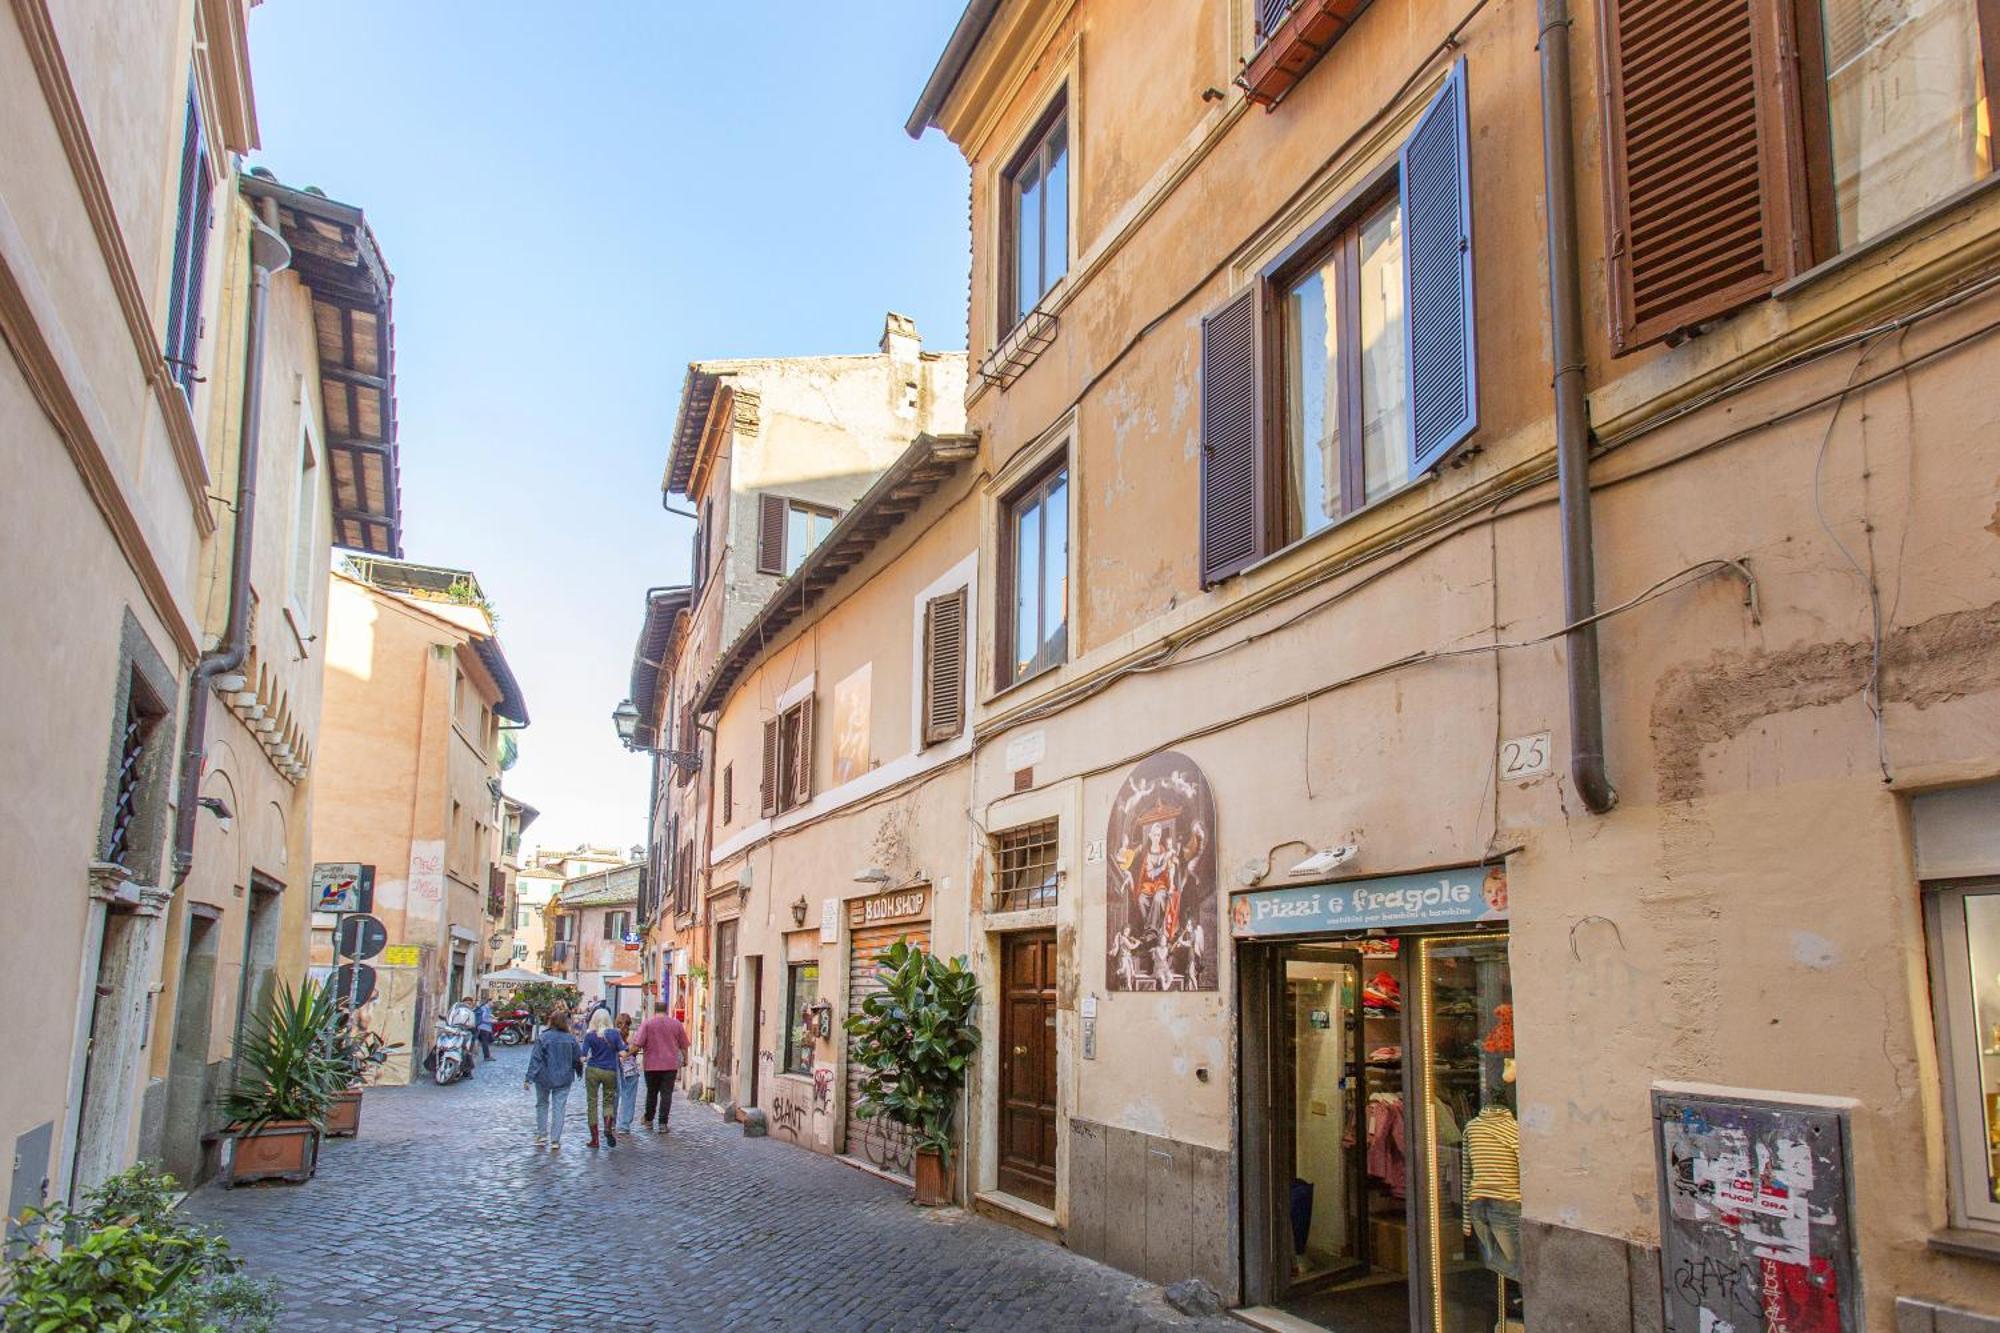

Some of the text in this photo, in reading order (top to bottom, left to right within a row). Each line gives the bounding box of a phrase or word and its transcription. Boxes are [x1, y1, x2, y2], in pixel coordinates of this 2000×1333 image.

[1504, 737, 1543, 772] 25
[1255, 879, 1472, 920] Pizzi e fragole
